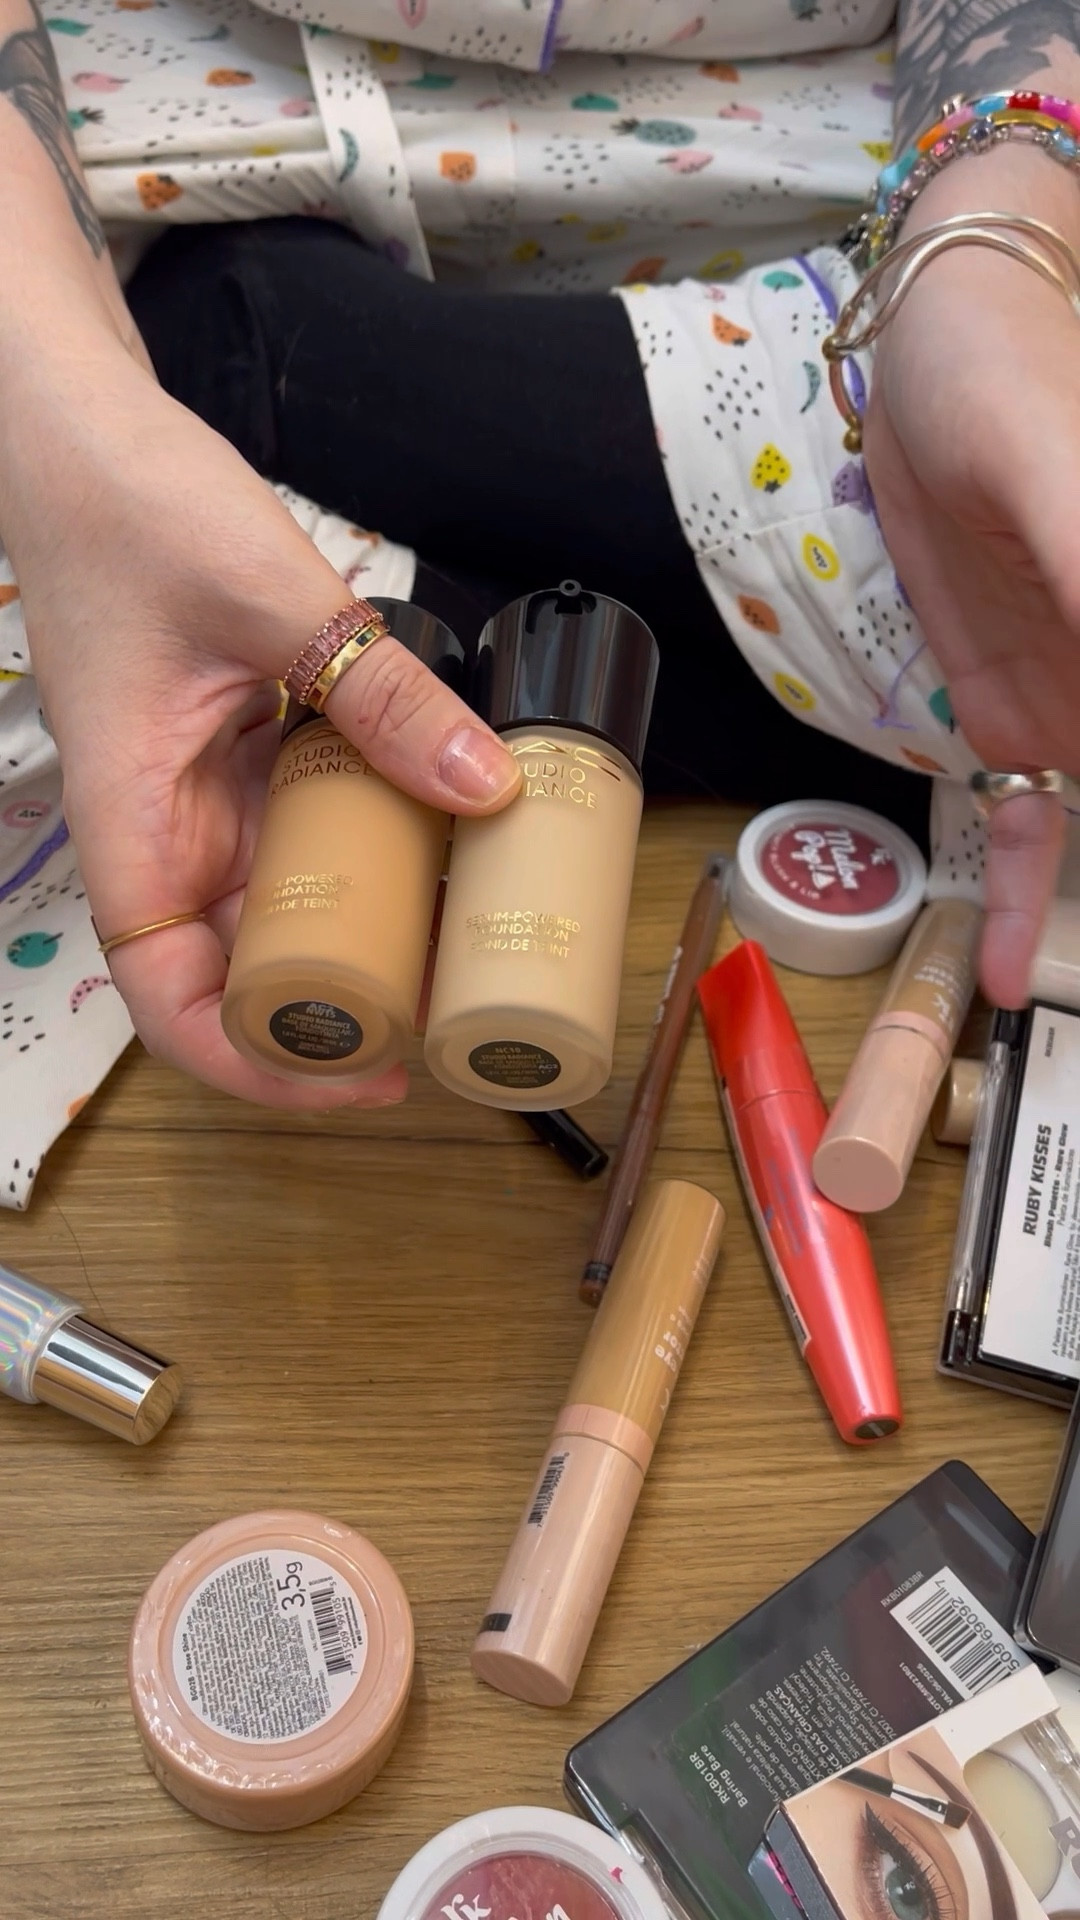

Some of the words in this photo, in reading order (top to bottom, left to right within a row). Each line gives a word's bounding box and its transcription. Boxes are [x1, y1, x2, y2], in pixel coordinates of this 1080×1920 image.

[282, 745, 361, 775] STUDIO
[520, 763, 586, 784] UDIO
[525, 781, 597, 809] IANCE
[510, 938, 530, 951] DE
[1057, 1122, 1069, 1147] Glow
[1029, 1122, 1052, 1183] KISSES
[1053, 1147, 1065, 1172] Rare
[1022, 1185, 1043, 1236] RUBY
[1047, 1178, 1061, 1217] Palette
[1043, 1218, 1055, 1248] Blush
[276, 1561, 306, 1612] 3,5g
[933, 1577, 945, 1588] 7
[331, 1596, 345, 1626] 99105
[950, 1595, 993, 1641] 69092
[180, 1632, 190, 1652] Shine
[338, 1629, 354, 1660] 31509
[991, 1640, 1021, 1672] 509
[183, 1652, 193, 1670] Rose
[811, 1652, 826, 1668] Tin
[787, 1670, 817, 1704] Tridecyl
[803, 1656, 861, 1726] Styrene/Isoprene
[745, 1701, 769, 1728] sobre
[755, 1695, 769, 1710] de
[763, 1688, 796, 1727] suspenda
[770, 1681, 815, 1734] CRIANÇAS.
[799, 1702, 813, 1716] 12
[764, 1706, 783, 1728] caso
[808, 1713, 824, 1730] em
[750, 1729, 772, 1754] pele.
[763, 1722, 794, 1759] produto
[778, 1725, 794, 1742] Em
[808, 1730, 829, 1754] DAS
[820, 1726, 852, 1765] consumir
[699, 1743, 721, 1771] Bare
[743, 1754, 753, 1764] e
[750, 1746, 776, 1776] beleza
[766, 1750, 781, 1765] de
[789, 1755, 799, 1765] o
[815, 1755, 829, 1769] de
[687, 1750, 731, 1804] RKB01BR
[718, 1767, 748, 1807] Baring
[771, 1773, 787, 1791] sua
[775, 1762, 802, 1793] idades
